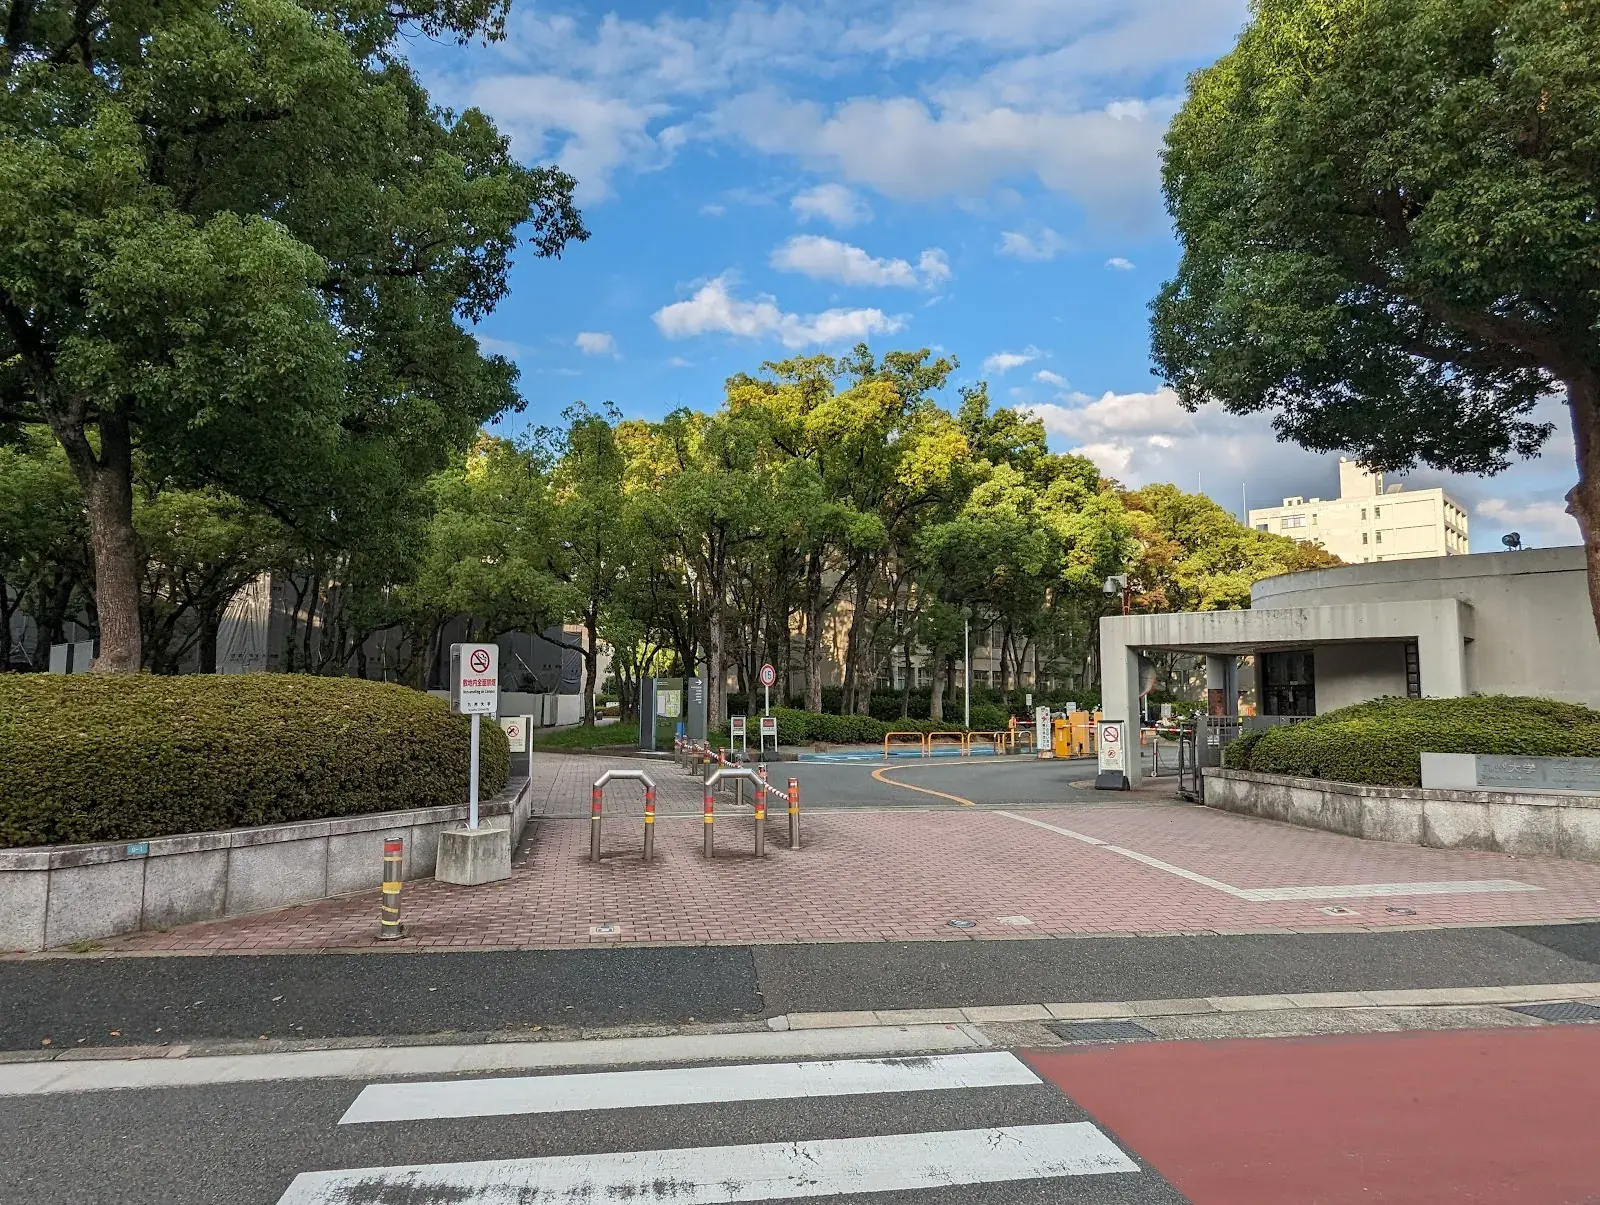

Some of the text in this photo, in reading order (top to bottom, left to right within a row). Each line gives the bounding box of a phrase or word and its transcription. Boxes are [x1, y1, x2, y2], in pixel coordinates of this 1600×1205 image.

[764, 670, 772, 680] 15
[1481, 761, 1537, 775] 九州大学
